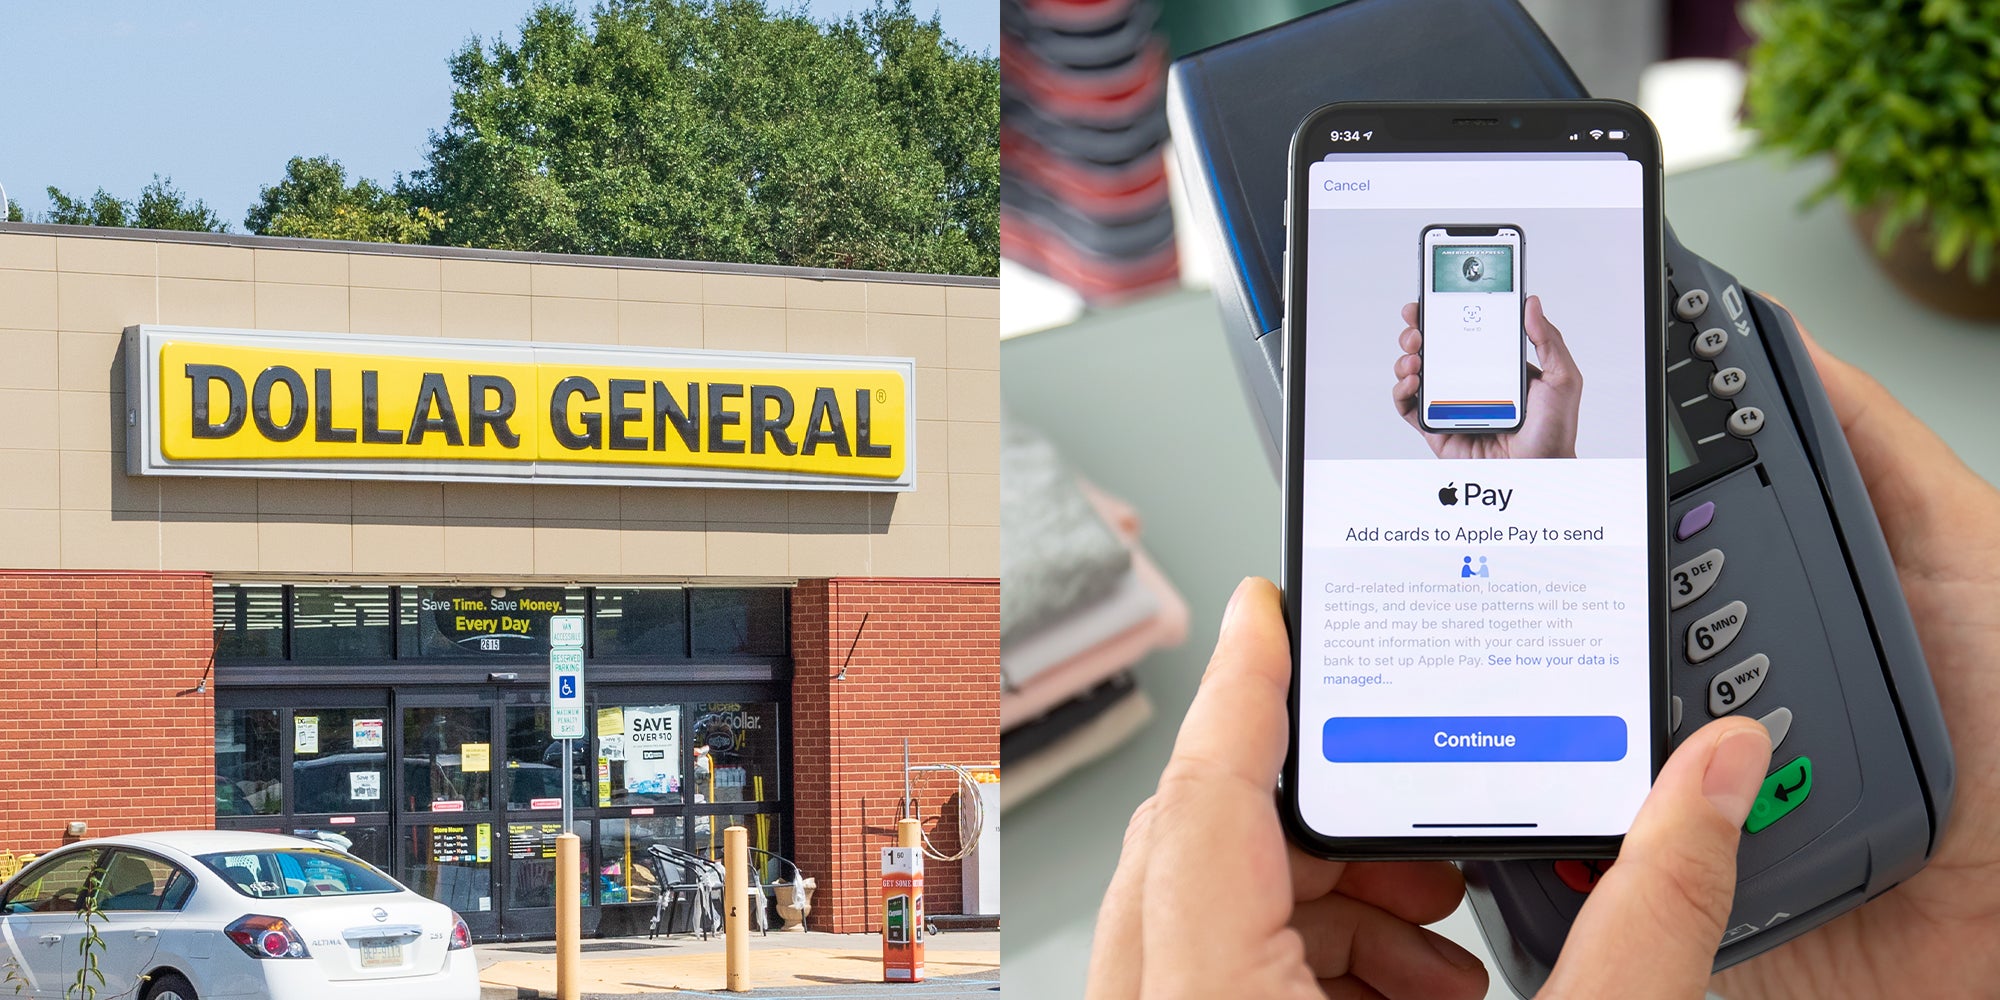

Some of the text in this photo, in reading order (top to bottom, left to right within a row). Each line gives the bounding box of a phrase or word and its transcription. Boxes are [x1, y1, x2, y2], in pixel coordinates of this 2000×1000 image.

[1330, 130, 1360, 142] 9:34
[1323, 179, 1371, 192] Cancel
[1688, 295, 1704, 308] F1
[1705, 333, 1722, 347] F2
[1723, 372, 1740, 386] F3
[185, 362, 892, 460] DOLLAR GENERAL
[1740, 411, 1758, 424] F4
[1464, 482, 1514, 512] Pay
[1346, 526, 1604, 544] Add cards to Apple Pay to send
[1674, 560, 1714, 596] 3 DEF
[1324, 580, 1587, 596] Card-related information, location, device
[422, 598, 562, 613] Save Time. Save Money.
[1324, 599, 1626, 613] settings, and device use patterns will be sent to
[456, 616, 532, 633] Every Day.
[1324, 617, 1573, 632] Apple and may be shared together with
[554, 632, 580, 640] ACCESSIBLE
[1695, 614, 1738, 650] 6 MNO
[481, 640, 500, 650] 2615
[1324, 636, 1603, 650] account information with your card issuer or
[554, 654, 580, 662] RESERVED
[1324, 654, 1620, 668] bank to set up Apple Pay. See how your data is
[556, 664, 580, 672] PARKING
[1324, 673, 1392, 686] managed...
[1716, 666, 1760, 705] 9 WXY
[633, 718, 672, 732] SAVE
[632, 732, 672, 742] OVER $10
[1434, 732, 1516, 748] Continue
